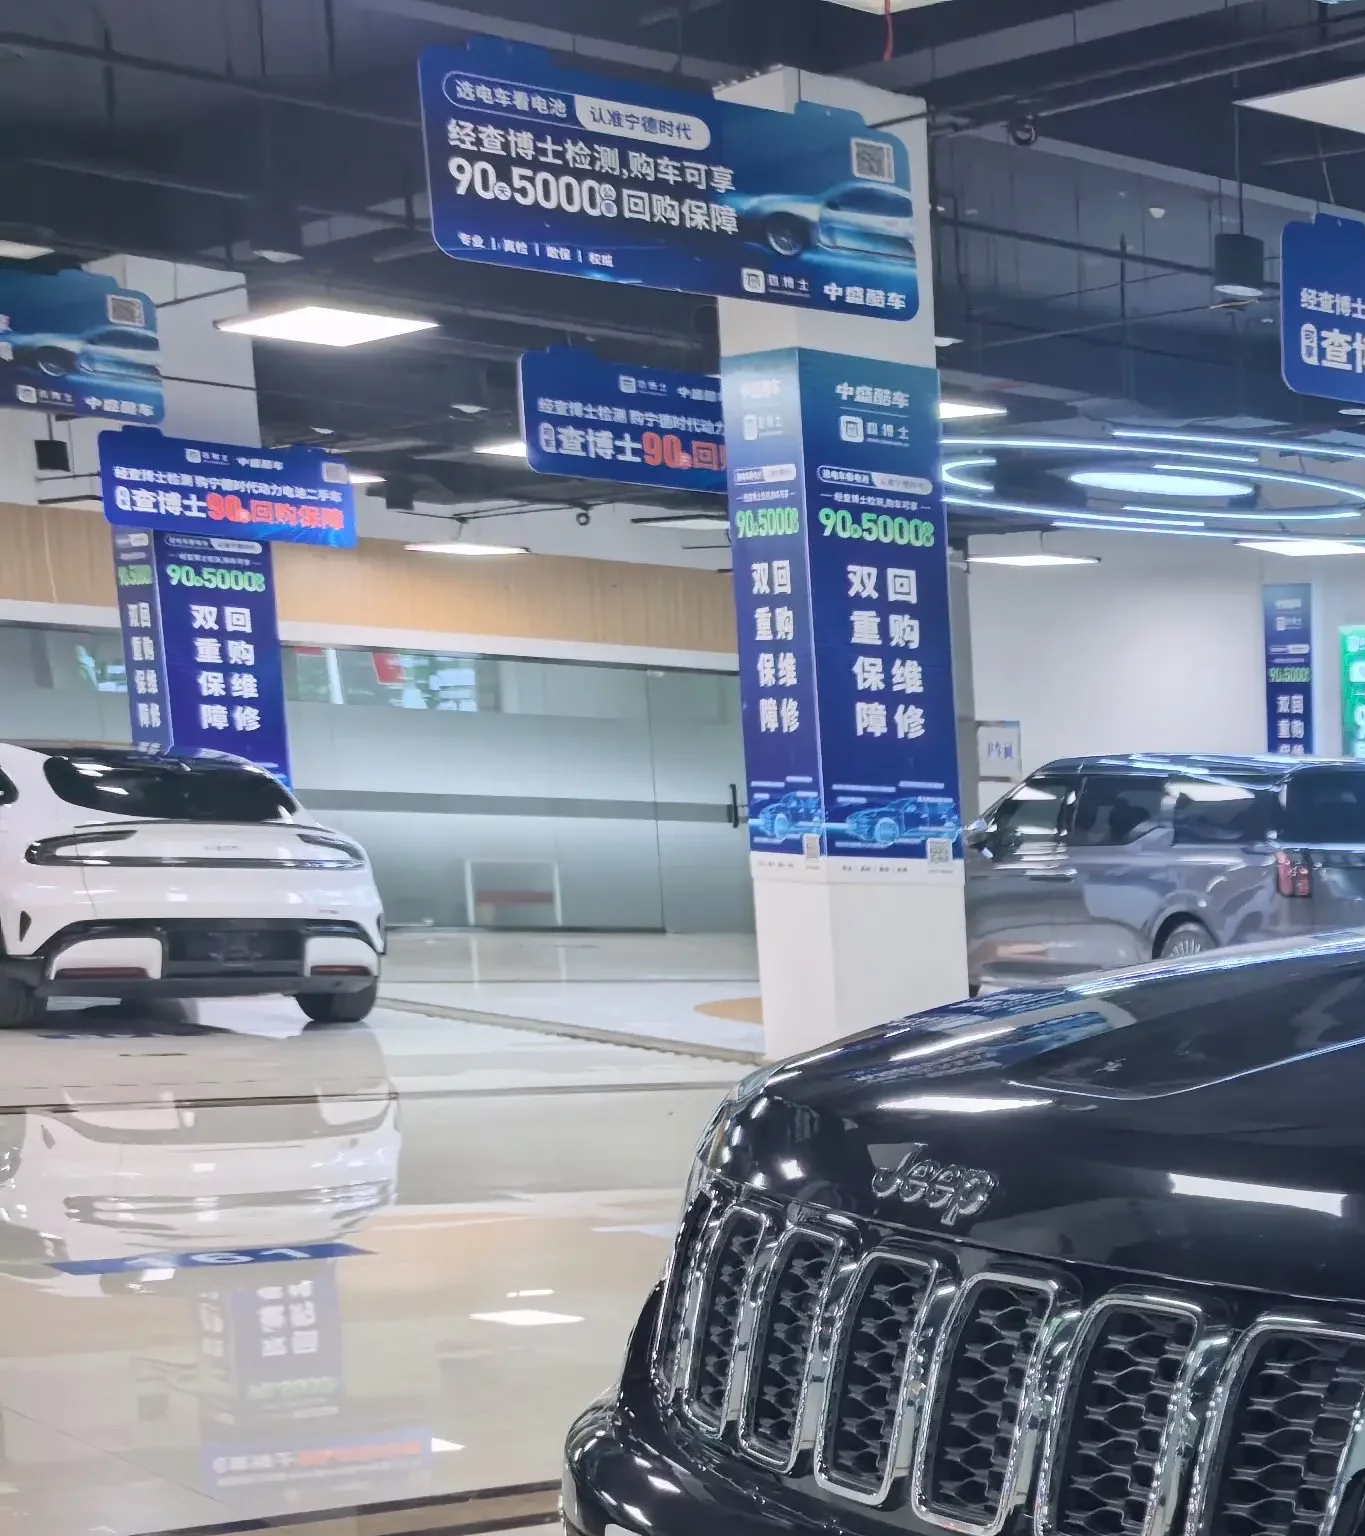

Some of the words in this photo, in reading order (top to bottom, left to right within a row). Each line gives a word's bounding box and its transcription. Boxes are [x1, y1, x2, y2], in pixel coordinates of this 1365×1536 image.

[590, 105, 692, 141] 认准宁德时代
[622, 187, 739, 235] 回购保障
[871, 1141, 999, 1228] Jeep
